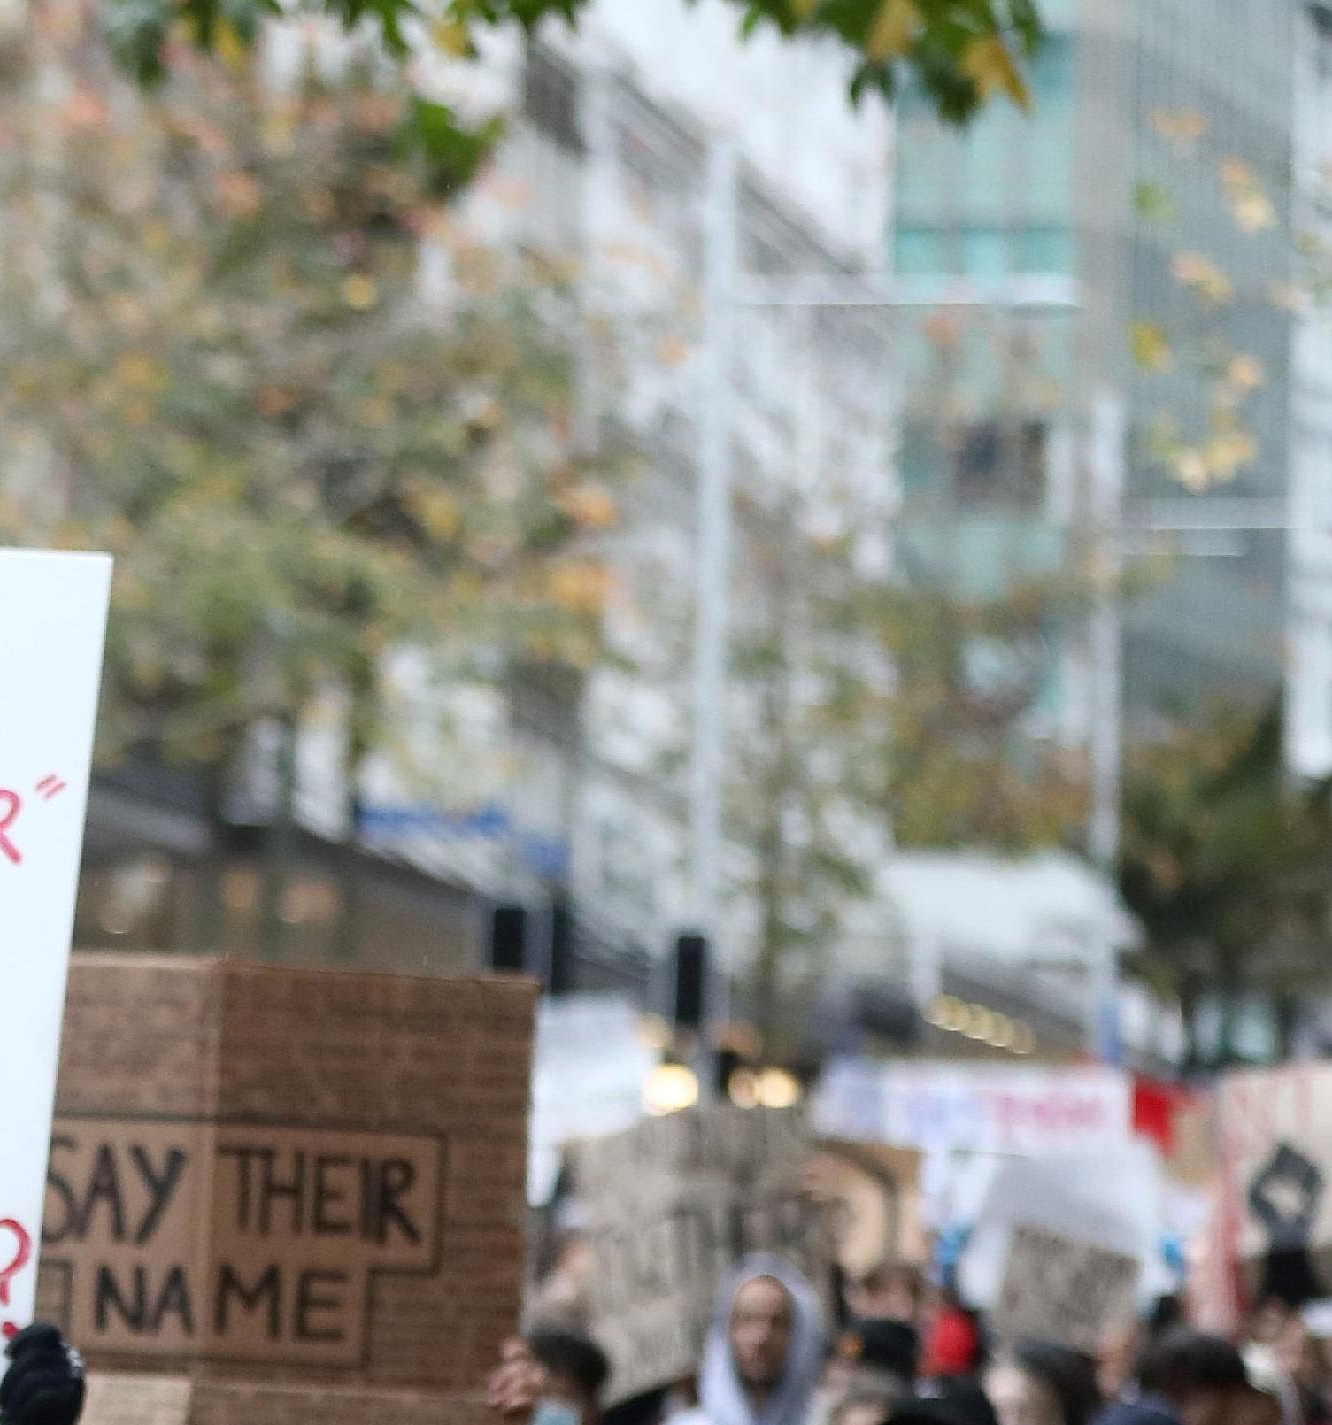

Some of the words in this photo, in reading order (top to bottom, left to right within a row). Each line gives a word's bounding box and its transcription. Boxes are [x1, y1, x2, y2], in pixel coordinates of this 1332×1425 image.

[41, 1134, 189, 1248] SAY
[214, 1144, 423, 1247] THEIR
[92, 1262, 348, 1346] NAME
